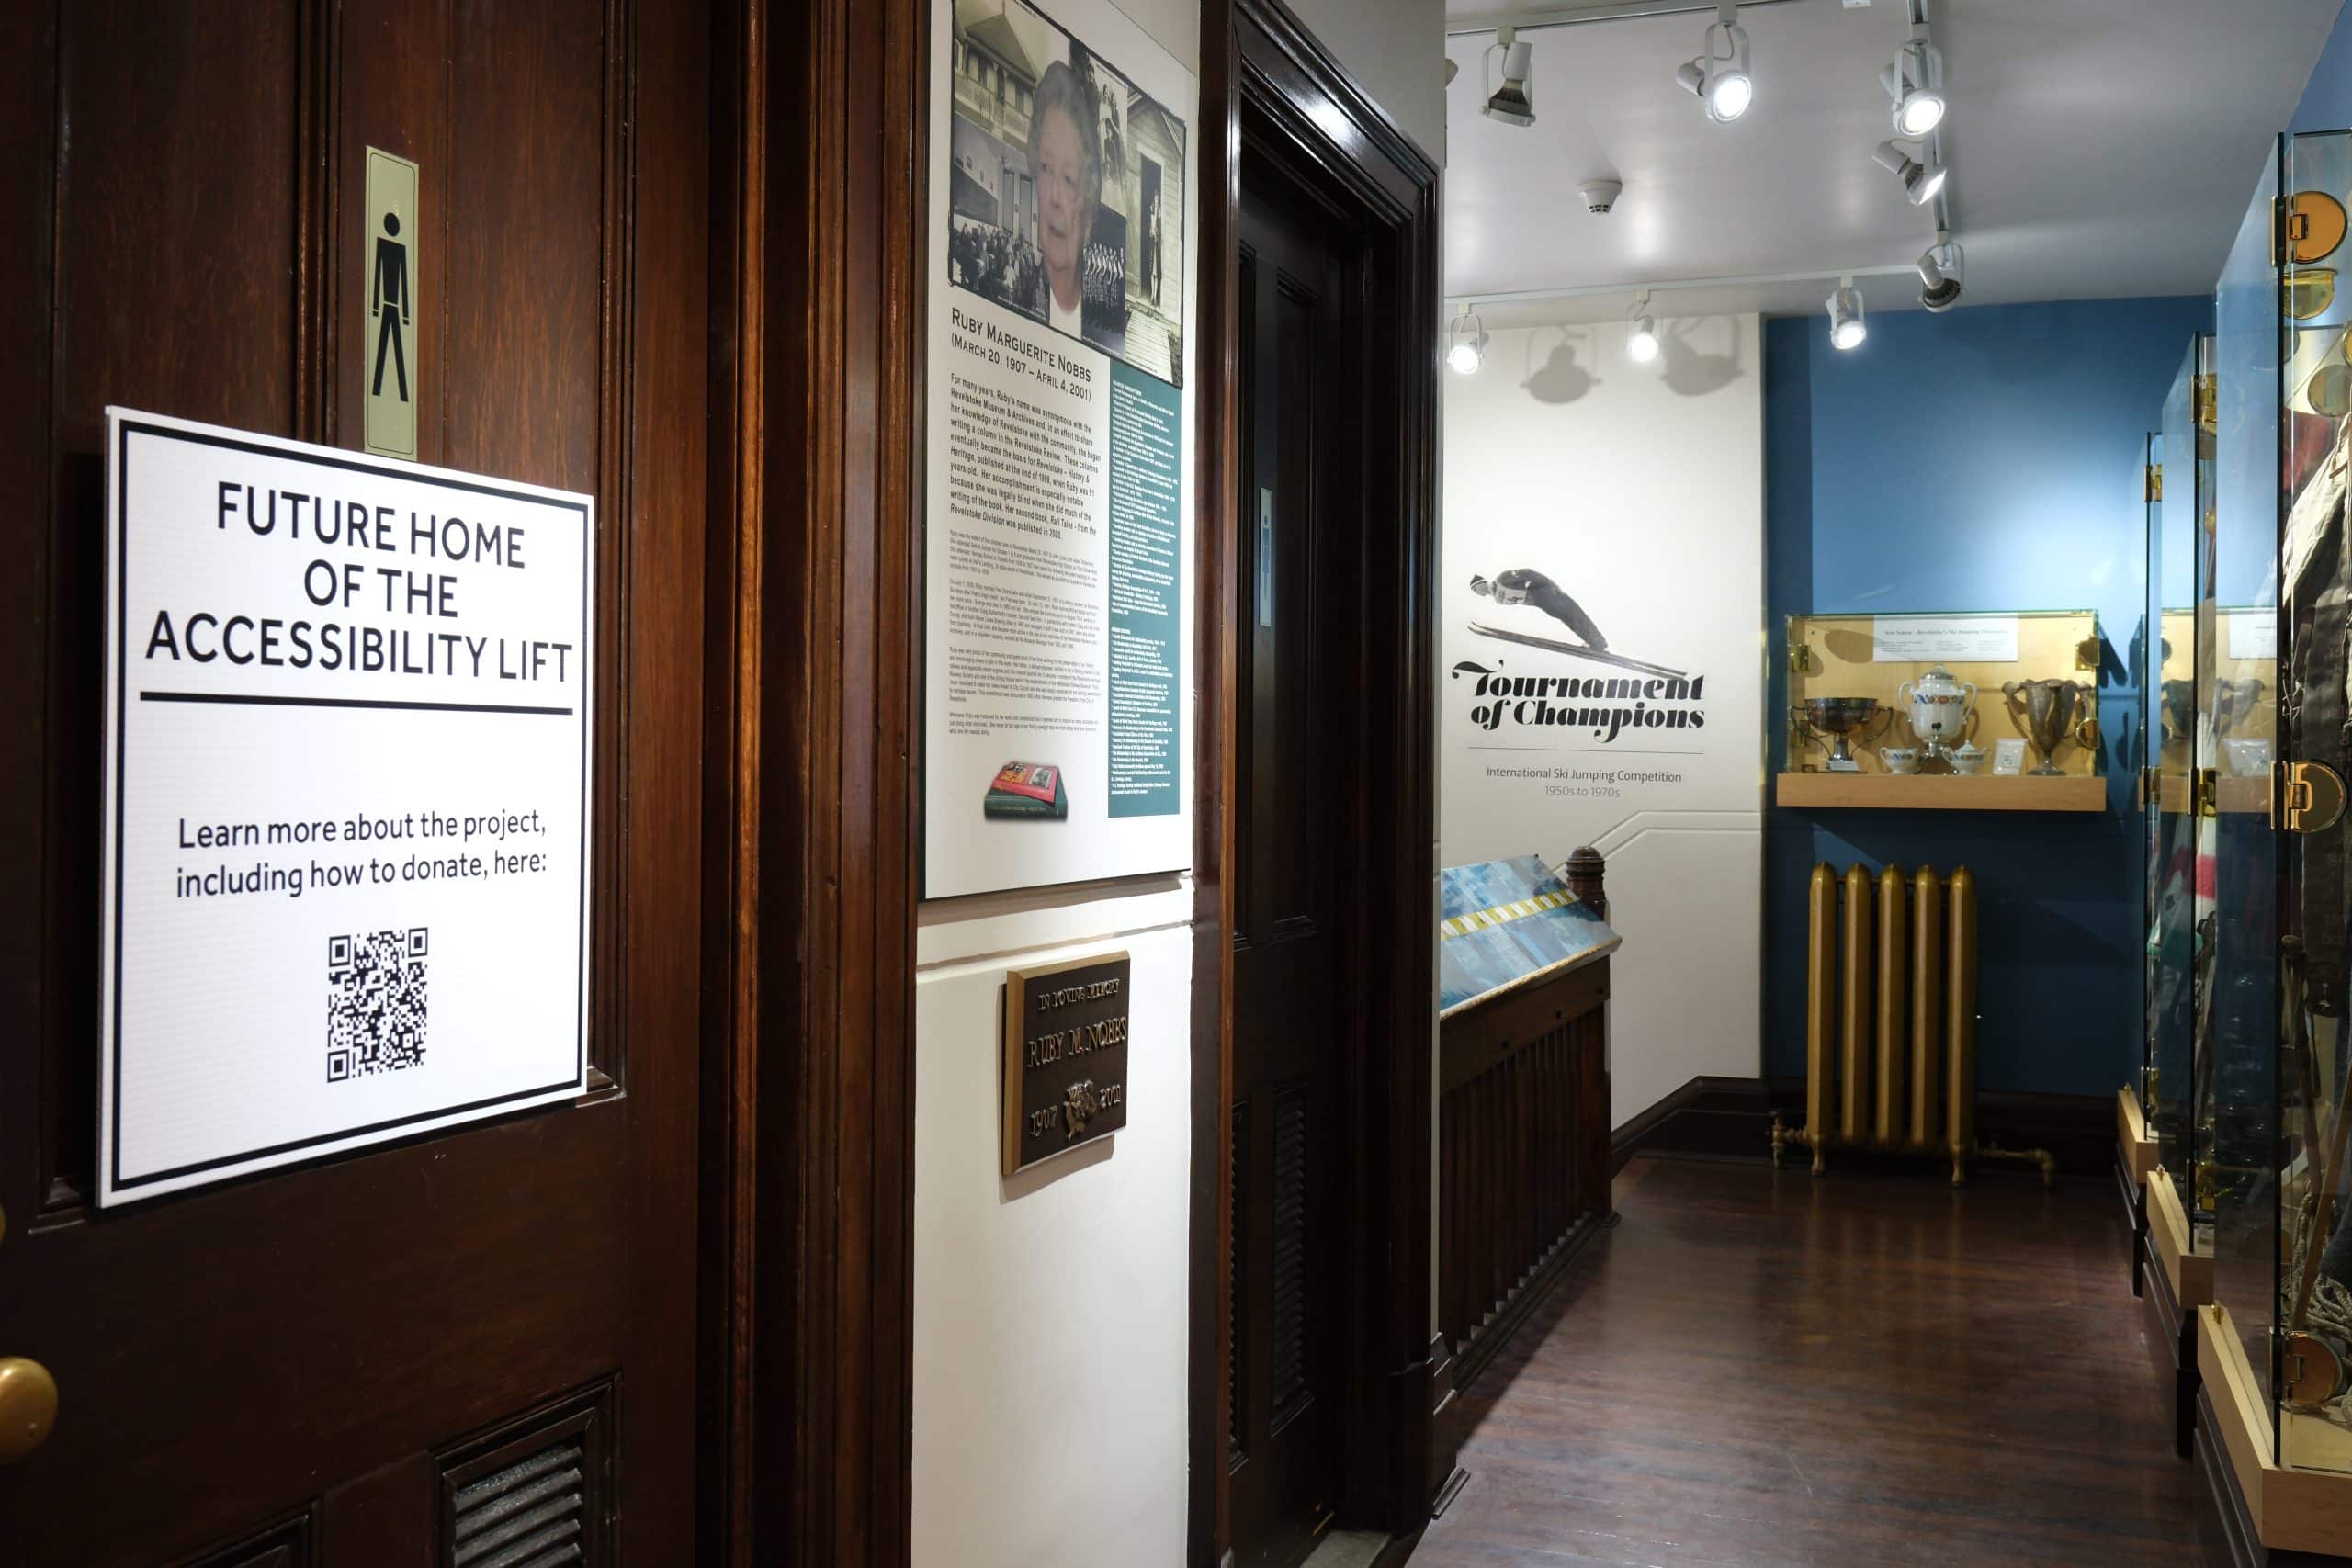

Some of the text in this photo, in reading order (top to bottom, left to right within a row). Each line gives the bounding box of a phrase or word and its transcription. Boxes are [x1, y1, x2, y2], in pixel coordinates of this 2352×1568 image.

[951, 307, 982, 335] RUBY
[986, 324, 1055, 366] MARGUERITE
[1057, 355, 1091, 381] NOBBS
[951, 333, 985, 358] (MARCH
[988, 349, 1002, 367] 20,
[1006, 356, 1026, 374] 1907
[1035, 369, 1059, 388] APRIL
[1069, 383, 1091, 401] 2001)
[950, 372, 961, 384] For
[962, 379, 977, 393] many
[1041, 410, 1072, 426] synonymous
[950, 387, 981, 407] Revelstoke
[983, 399, 1005, 415] Museum
[1012, 410, 1034, 425] Archives
[1074, 433, 1079, 441] to
[950, 402, 961, 413] her
[961, 406, 992, 425] knowledge
[992, 417, 998, 426] of
[999, 419, 1028, 437] Revelstoke
[1078, 448, 1086, 457] she
[950, 419, 970, 433] writing
[976, 427, 997, 439] column
[1014, 438, 1042, 455] Revelstoke
[1064, 454, 1078, 467] These
[1079, 462, 1098, 473] columns
[950, 433, 979, 450] eventually
[980, 441, 1002, 455] became
[1012, 451, 1027, 463] basis
[1027, 455, 1035, 466] for
[1036, 458, 1063, 474] Revelstoke
[1067, 469, 1085, 483] History
[977, 456, 1004, 469] published
[1005, 463, 1011, 472] at
[1020, 469, 1031, 478] end
[1032, 471, 1038, 479] of
[1052, 477, 1065, 488] when
[1065, 481, 1078, 494] Ruby
[950, 462, 966, 473] years
[981, 469, 991, 479] Her
[992, 474, 1034, 492] accomplishment
[1041, 489, 1065, 503] especially
[950, 474, 973, 489] because
[975, 483, 985, 492] she
[998, 488, 1016, 503] legally
[1017, 493, 1030, 505] blind
[1031, 499, 1044, 508] when
[1045, 502, 1054, 511] she
[1077, 511, 1083, 519] of
[219, 481, 524, 568] FUTURE HOME
[950, 491, 970, 504] writing
[971, 495, 977, 505] of
[1005, 504, 1014, 514] Her
[1015, 508, 1034, 519] second
[1077, 522, 1088, 532] from
[950, 503, 981, 519] Revelstoke
[982, 511, 1004, 525] Division
[1017, 522, 1042, 534] published
[305, 560, 457, 617] OF THE
[146, 610, 571, 682] ACCESSIBILITY LIFT
[1452, 660, 1704, 700] Tournament
[1471, 699, 1704, 743] of Champions
[1487, 767, 1682, 785] International Ski Jumping Competition
[1545, 785, 1620, 798] 1950s to 1970s
[180, 811, 546, 848] Learn more about the project,
[178, 851, 547, 897] including how to donate, here:
[1038, 994, 1051, 1010] IN
[1052, 986, 1085, 1007] LOVING
[1027, 1032, 1064, 1067] RUBY
[1085, 1016, 1127, 1051] NOBBS
[1100, 1084, 1123, 1109] 2001
[1030, 1105, 1058, 1137] 1907
